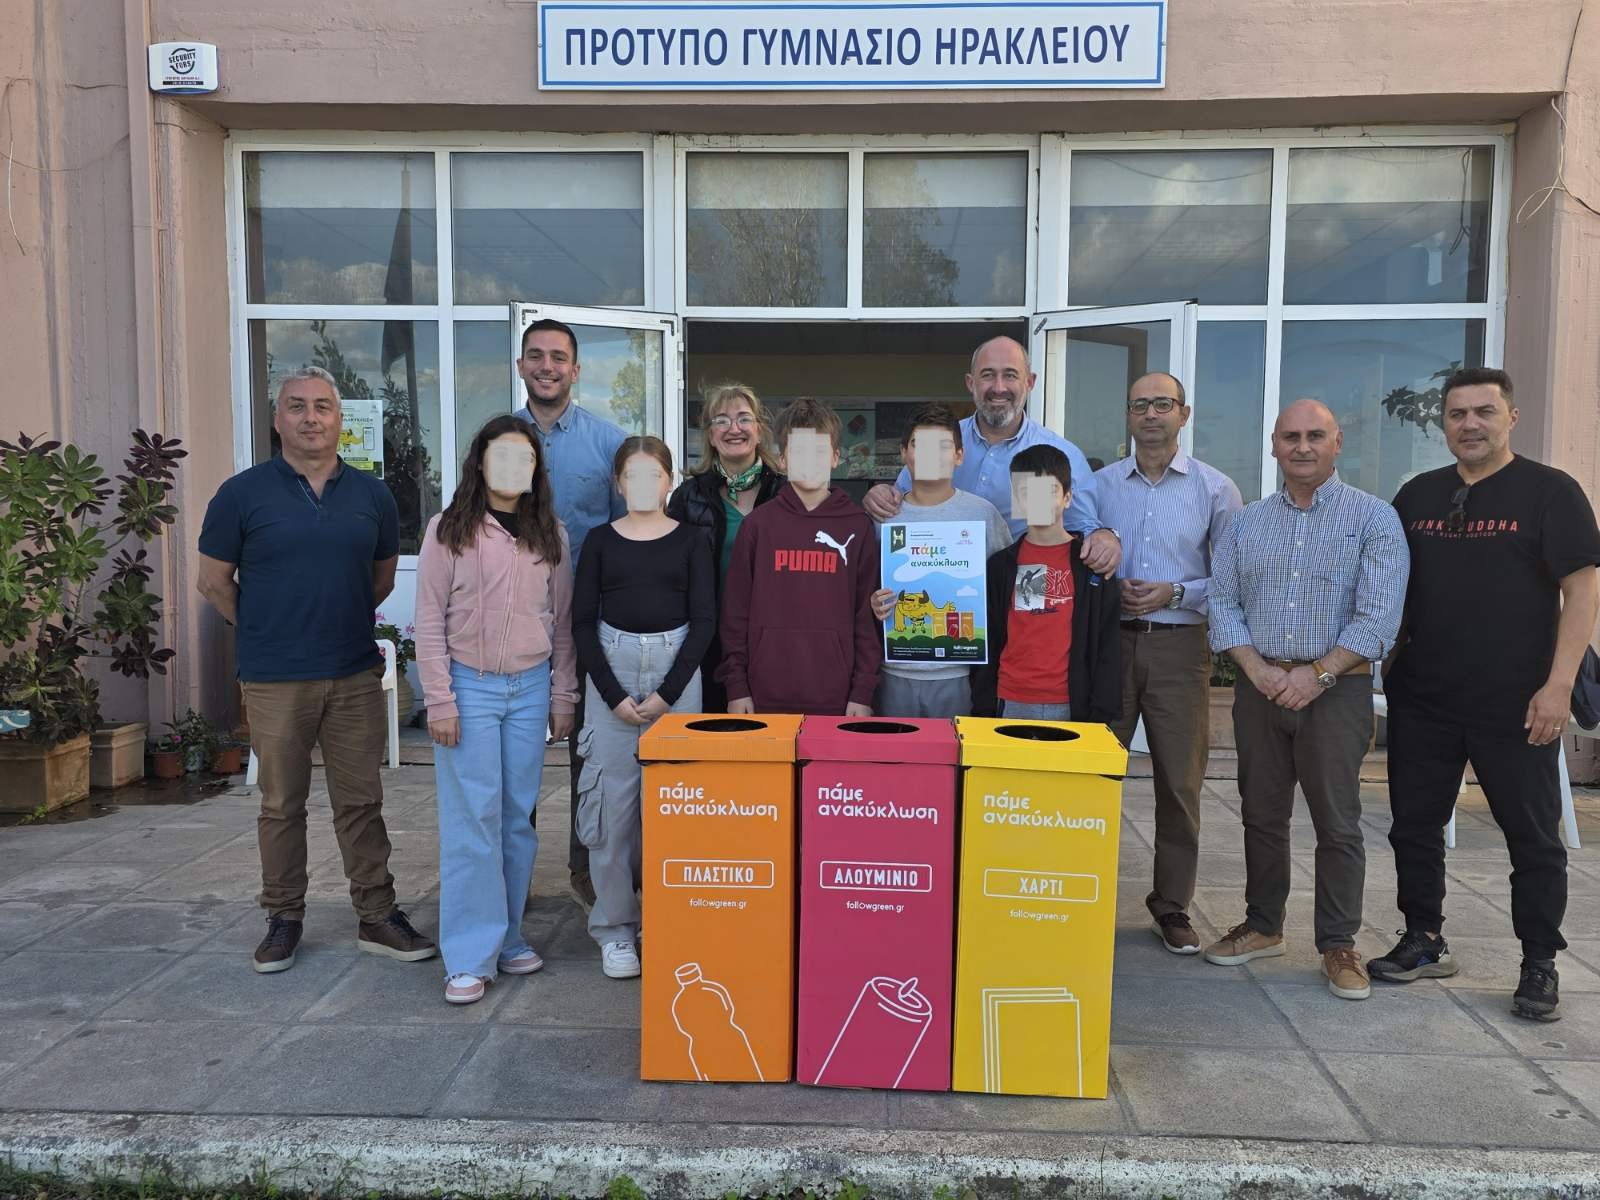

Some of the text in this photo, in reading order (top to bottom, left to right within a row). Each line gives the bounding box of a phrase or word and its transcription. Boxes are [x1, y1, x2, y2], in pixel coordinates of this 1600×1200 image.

[565, 24, 1130, 66] ΠΡΟΤΥΠΟ ΓΥΜΝΑΣΙΟ ΗΡΑΚΛΕΙΟΥ
[168, 52, 196, 63] SECURITY
[175, 60, 191, 69] FORS
[1410, 519, 1519, 532] JUNKUDDHA
[910, 544, 947, 558] πάμε
[775, 550, 838, 573] PUMA
[910, 558, 969, 569] ανακύκλωση
[659, 782, 705, 802] πάμε
[818, 782, 864, 803] πάμε
[983, 790, 1031, 811] πάμε
[659, 799, 778, 822] ανακύκλωση
[818, 801, 938, 825] ανακύκλωση
[983, 810, 1107, 836] ανακύκλωση
[683, 866, 754, 882] ΠΛΑΣΤΙΚΟ
[834, 867, 918, 887] ΑΛΟΥΜΙΝΙΟ
[1019, 877, 1063, 896] ΧΑΡΤΙ
